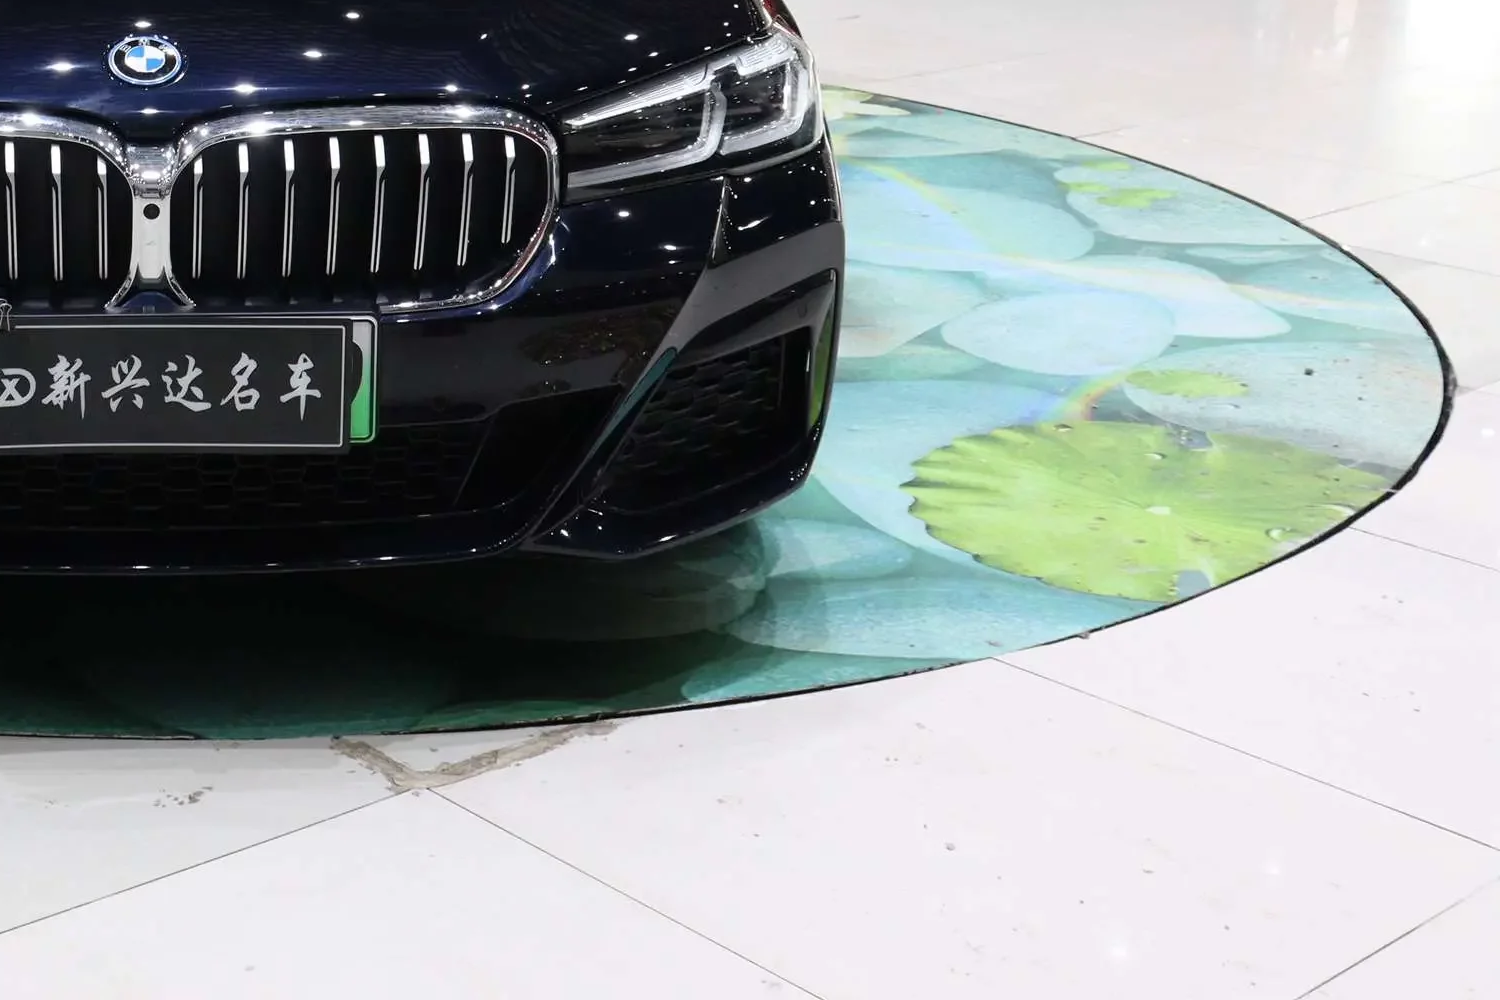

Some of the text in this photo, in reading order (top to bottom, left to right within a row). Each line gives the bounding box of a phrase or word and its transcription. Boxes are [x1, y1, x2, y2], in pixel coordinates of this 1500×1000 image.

[41, 352, 323, 421] 新兴达名车
